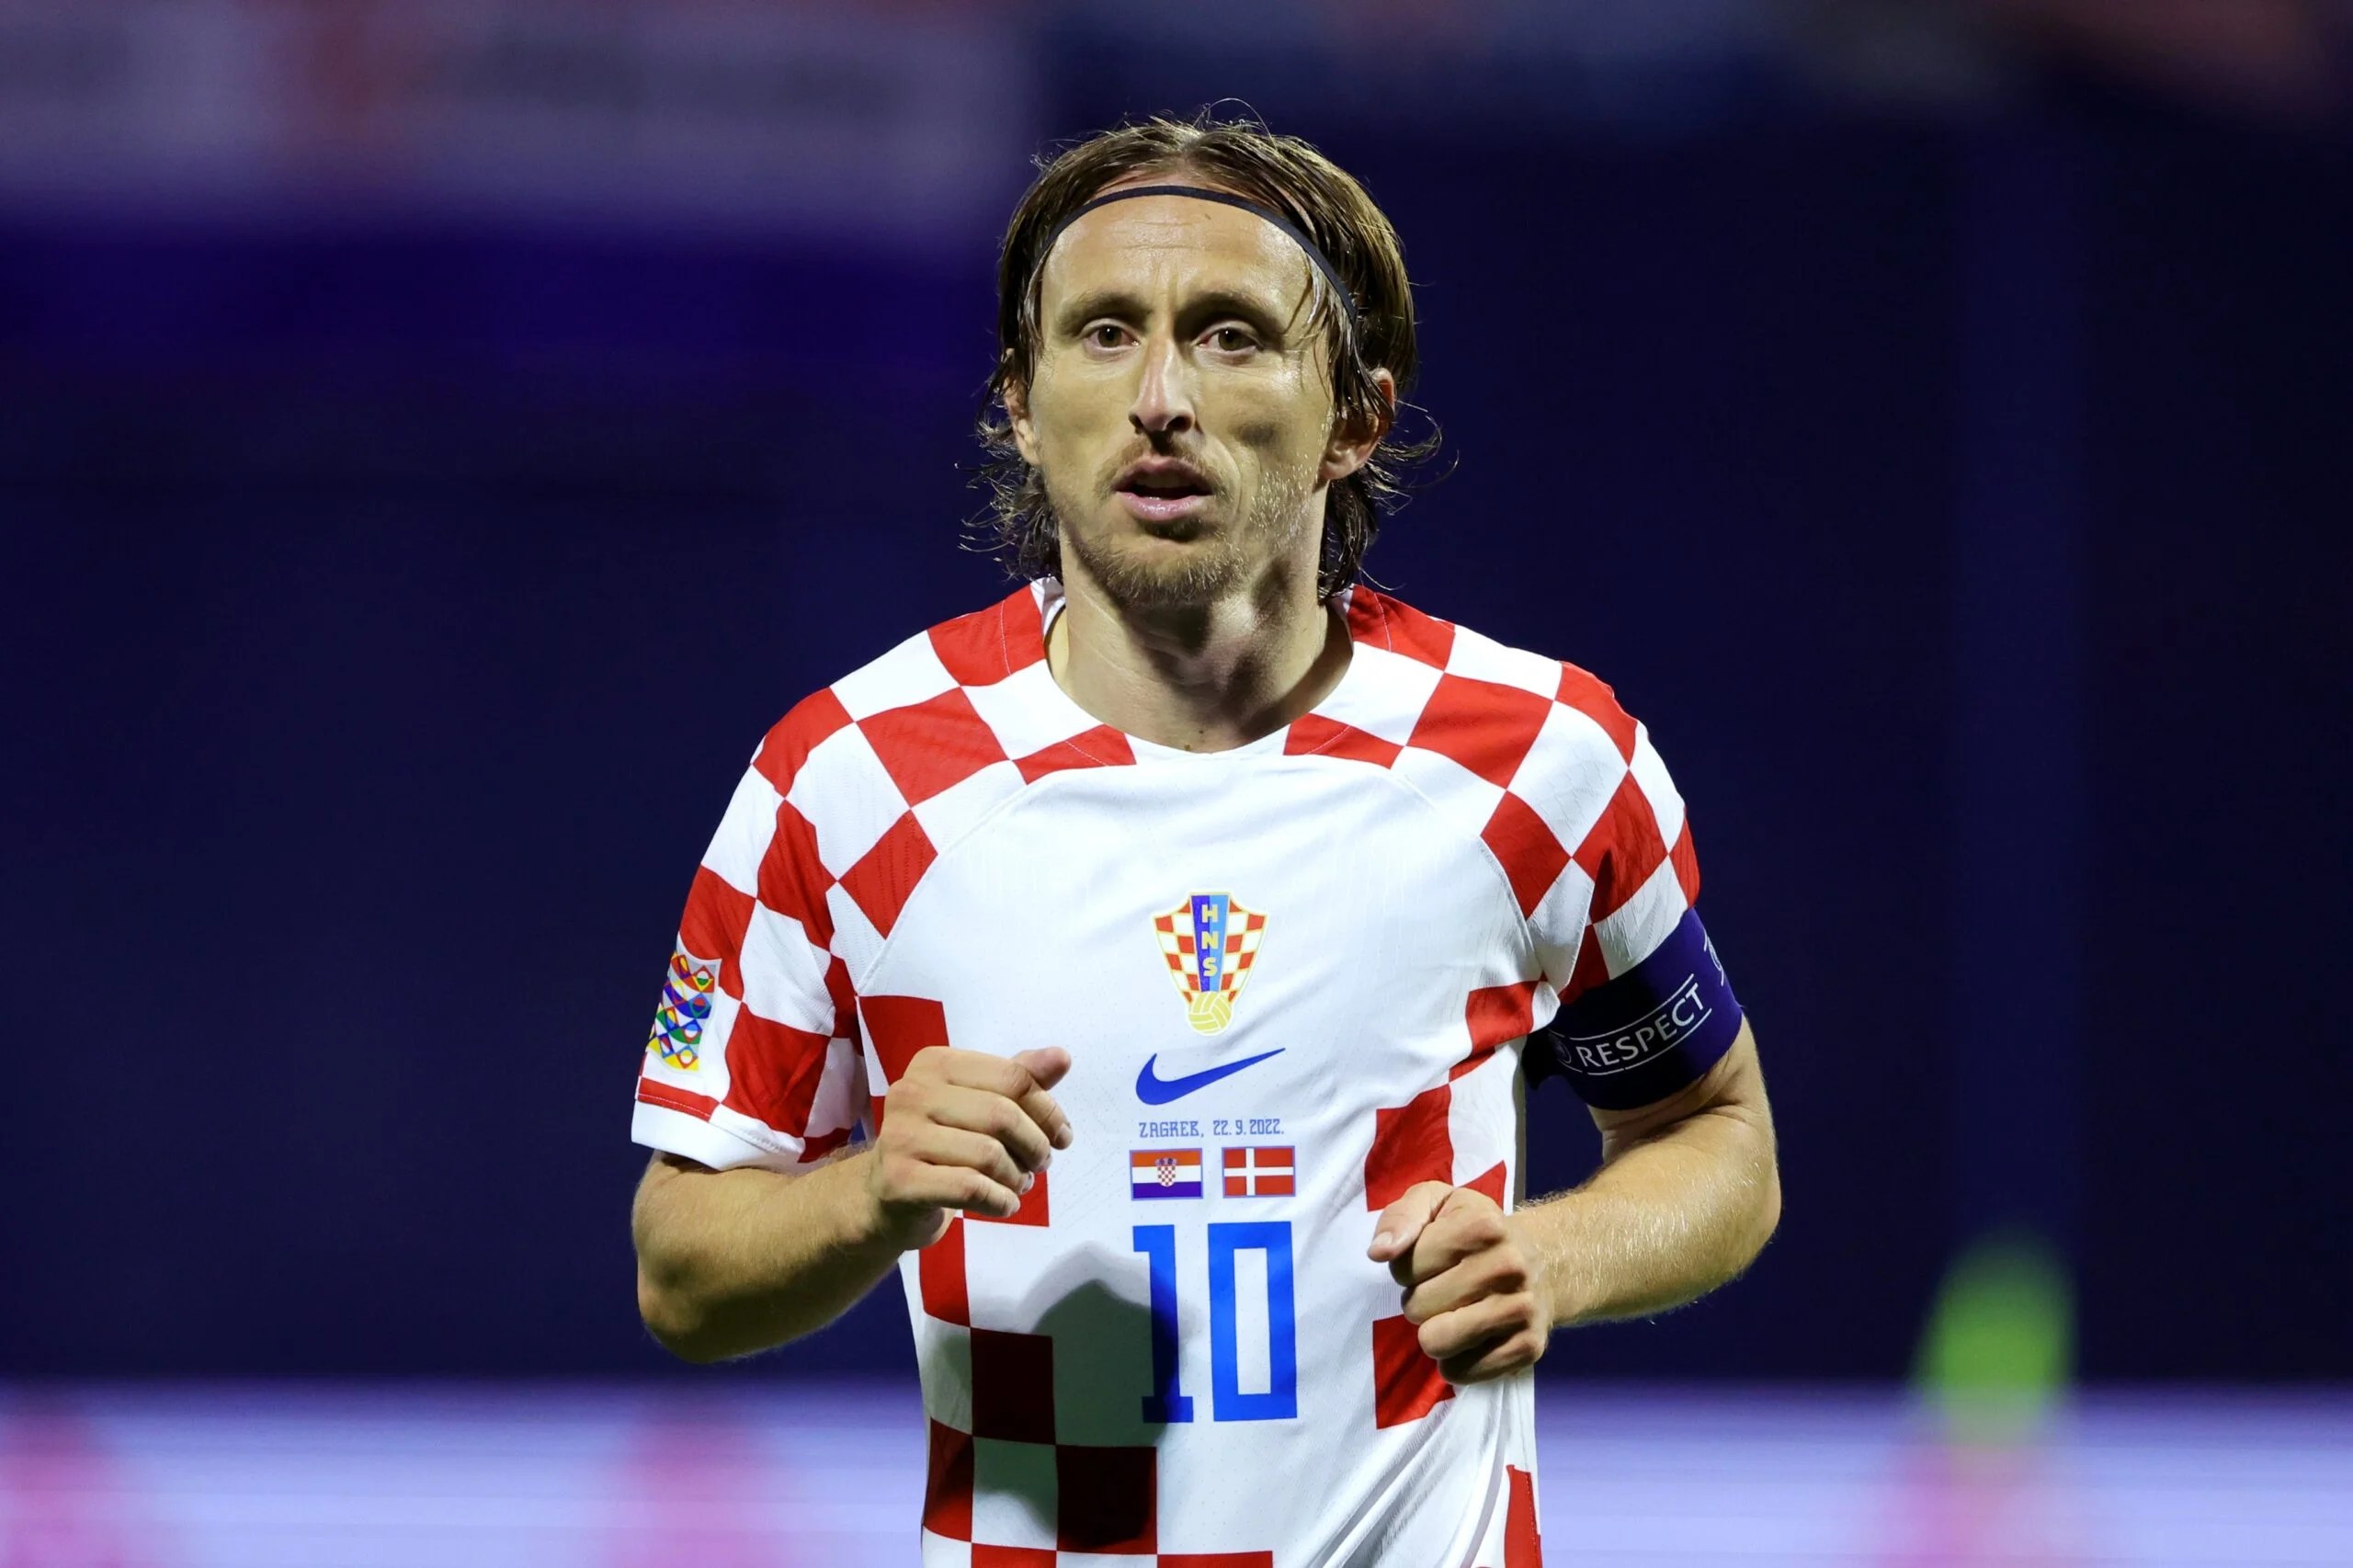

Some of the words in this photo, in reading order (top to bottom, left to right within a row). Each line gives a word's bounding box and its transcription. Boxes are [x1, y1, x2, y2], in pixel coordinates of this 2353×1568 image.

[1201, 904, 1219, 977] HNS
[1575, 983, 1704, 1067] RESPECT
[1139, 1120, 1204, 1138] ZAGREB,
[1132, 1221, 1297, 1423] 10
